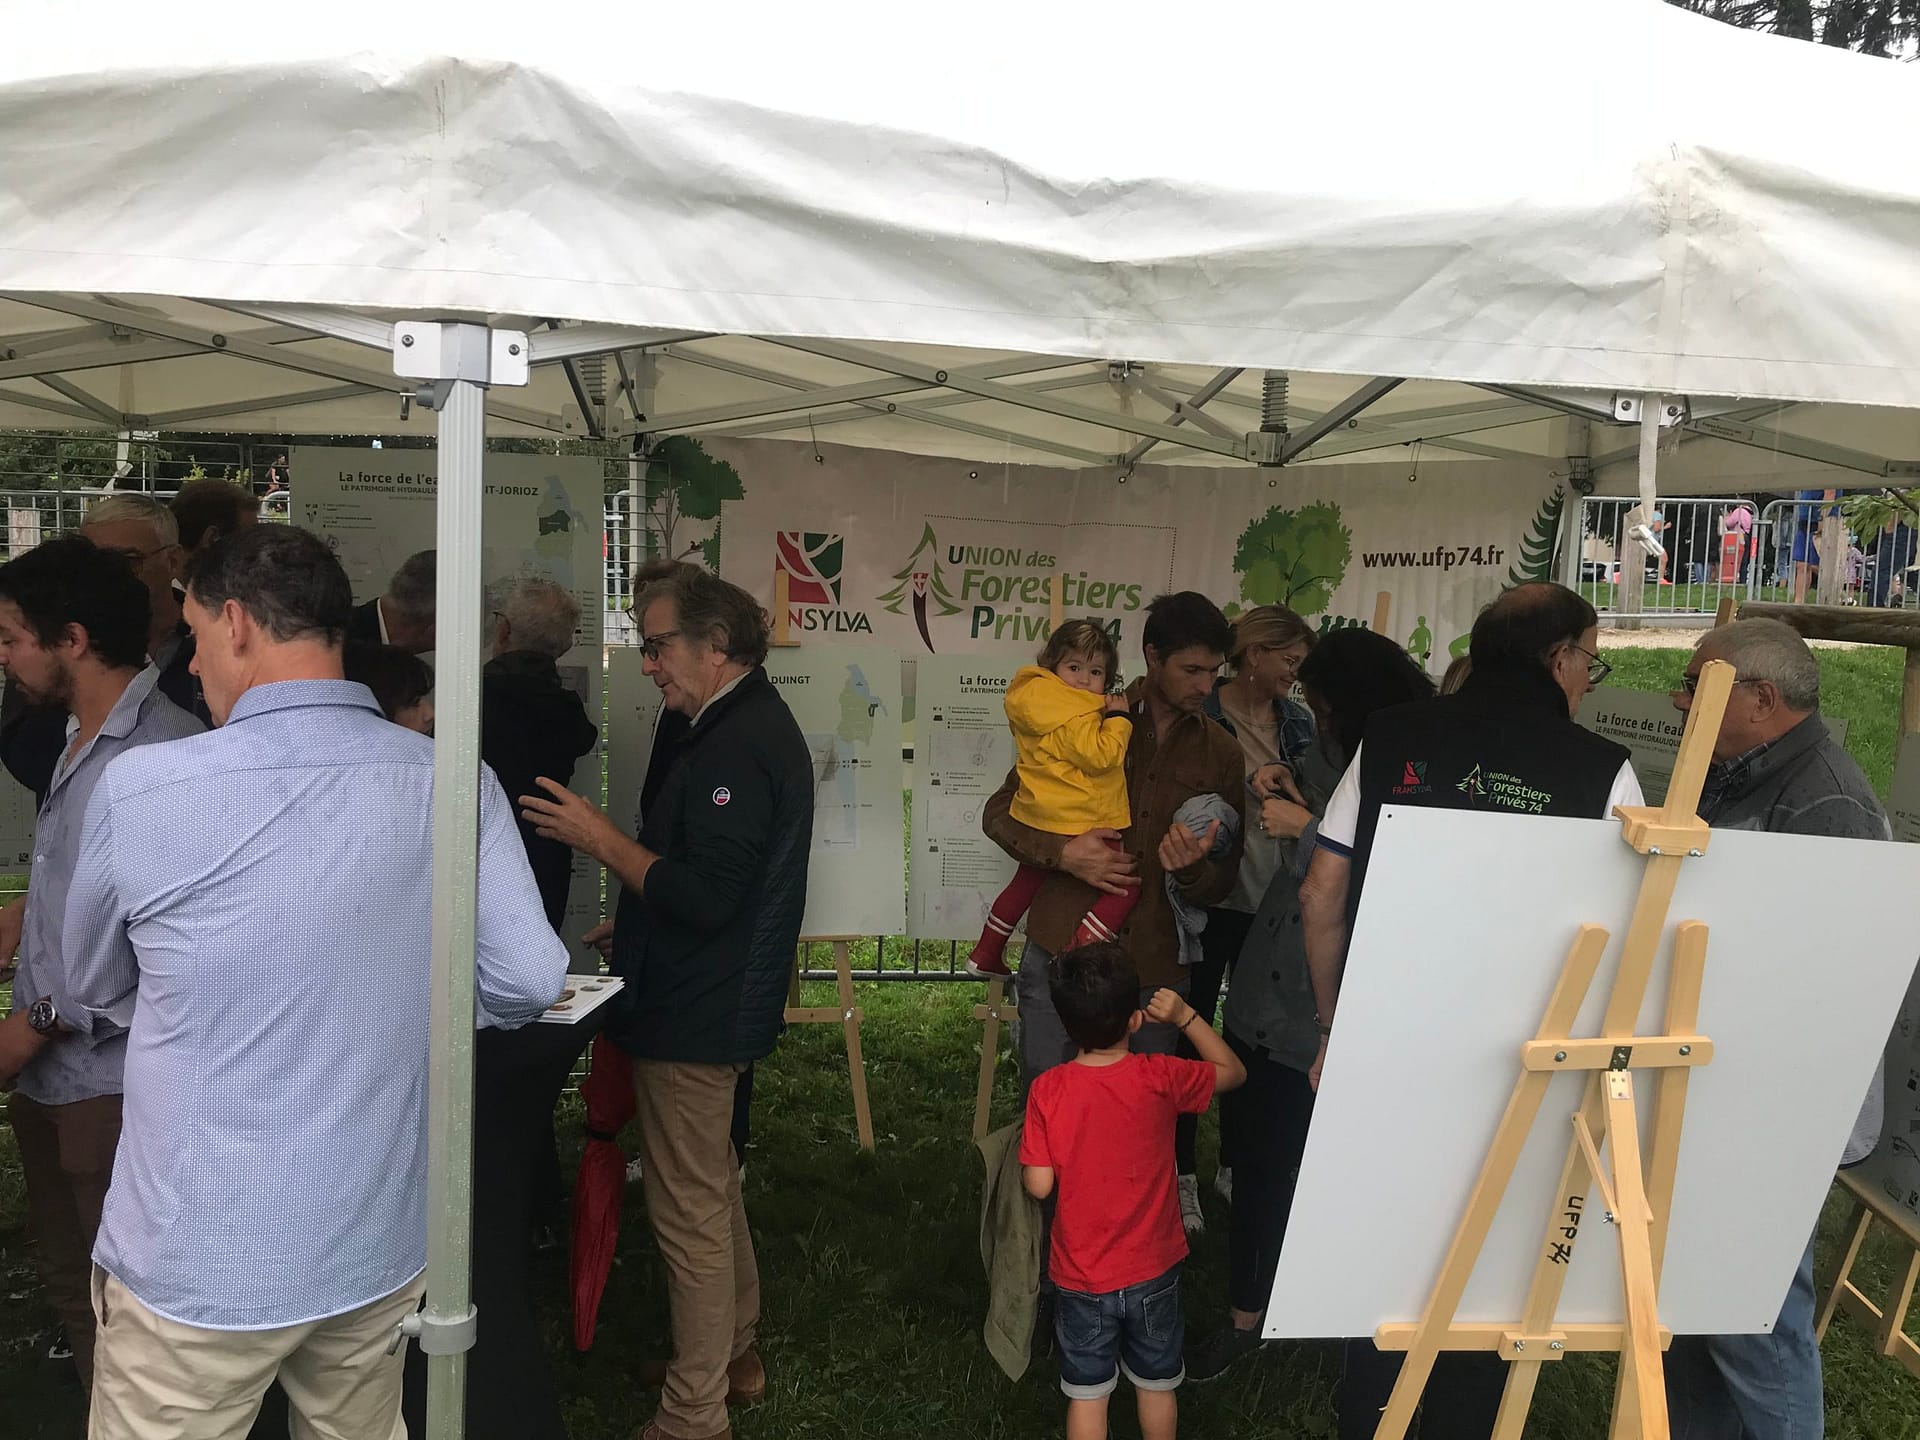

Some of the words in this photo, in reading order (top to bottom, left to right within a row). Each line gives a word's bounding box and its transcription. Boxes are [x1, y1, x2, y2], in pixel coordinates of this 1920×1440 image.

[339, 472, 353, 482] La
[358, 472, 392, 483] force
[397, 473, 412, 484] de
[417, 473, 438, 485] l'ea
[351, 485, 396, 493] PATRIMOINE
[948, 545, 1022, 567] UNION
[1025, 551, 1056, 568] des
[1362, 545, 1504, 571] www.ufp74.fr
[971, 605, 1052, 642] Priv
[771, 675, 811, 685] DUINGT
[960, 675, 973, 685] La
[977, 675, 1007, 686] force
[1596, 711, 1608, 724] La
[1611, 712, 1638, 729] force
[1641, 718, 1655, 733] de
[1657, 720, 1684, 737] l'eau
[1603, 728, 1638, 740] PATRIMOINE
[1483, 771, 1510, 781] UNION
[1509, 775, 1522, 784] des
[1487, 779, 1552, 803] Forestiers
[1488, 791, 1528, 809] Privés
[1528, 800, 1544, 814] 74
[1560, 1196, 1584, 1240] UFP
